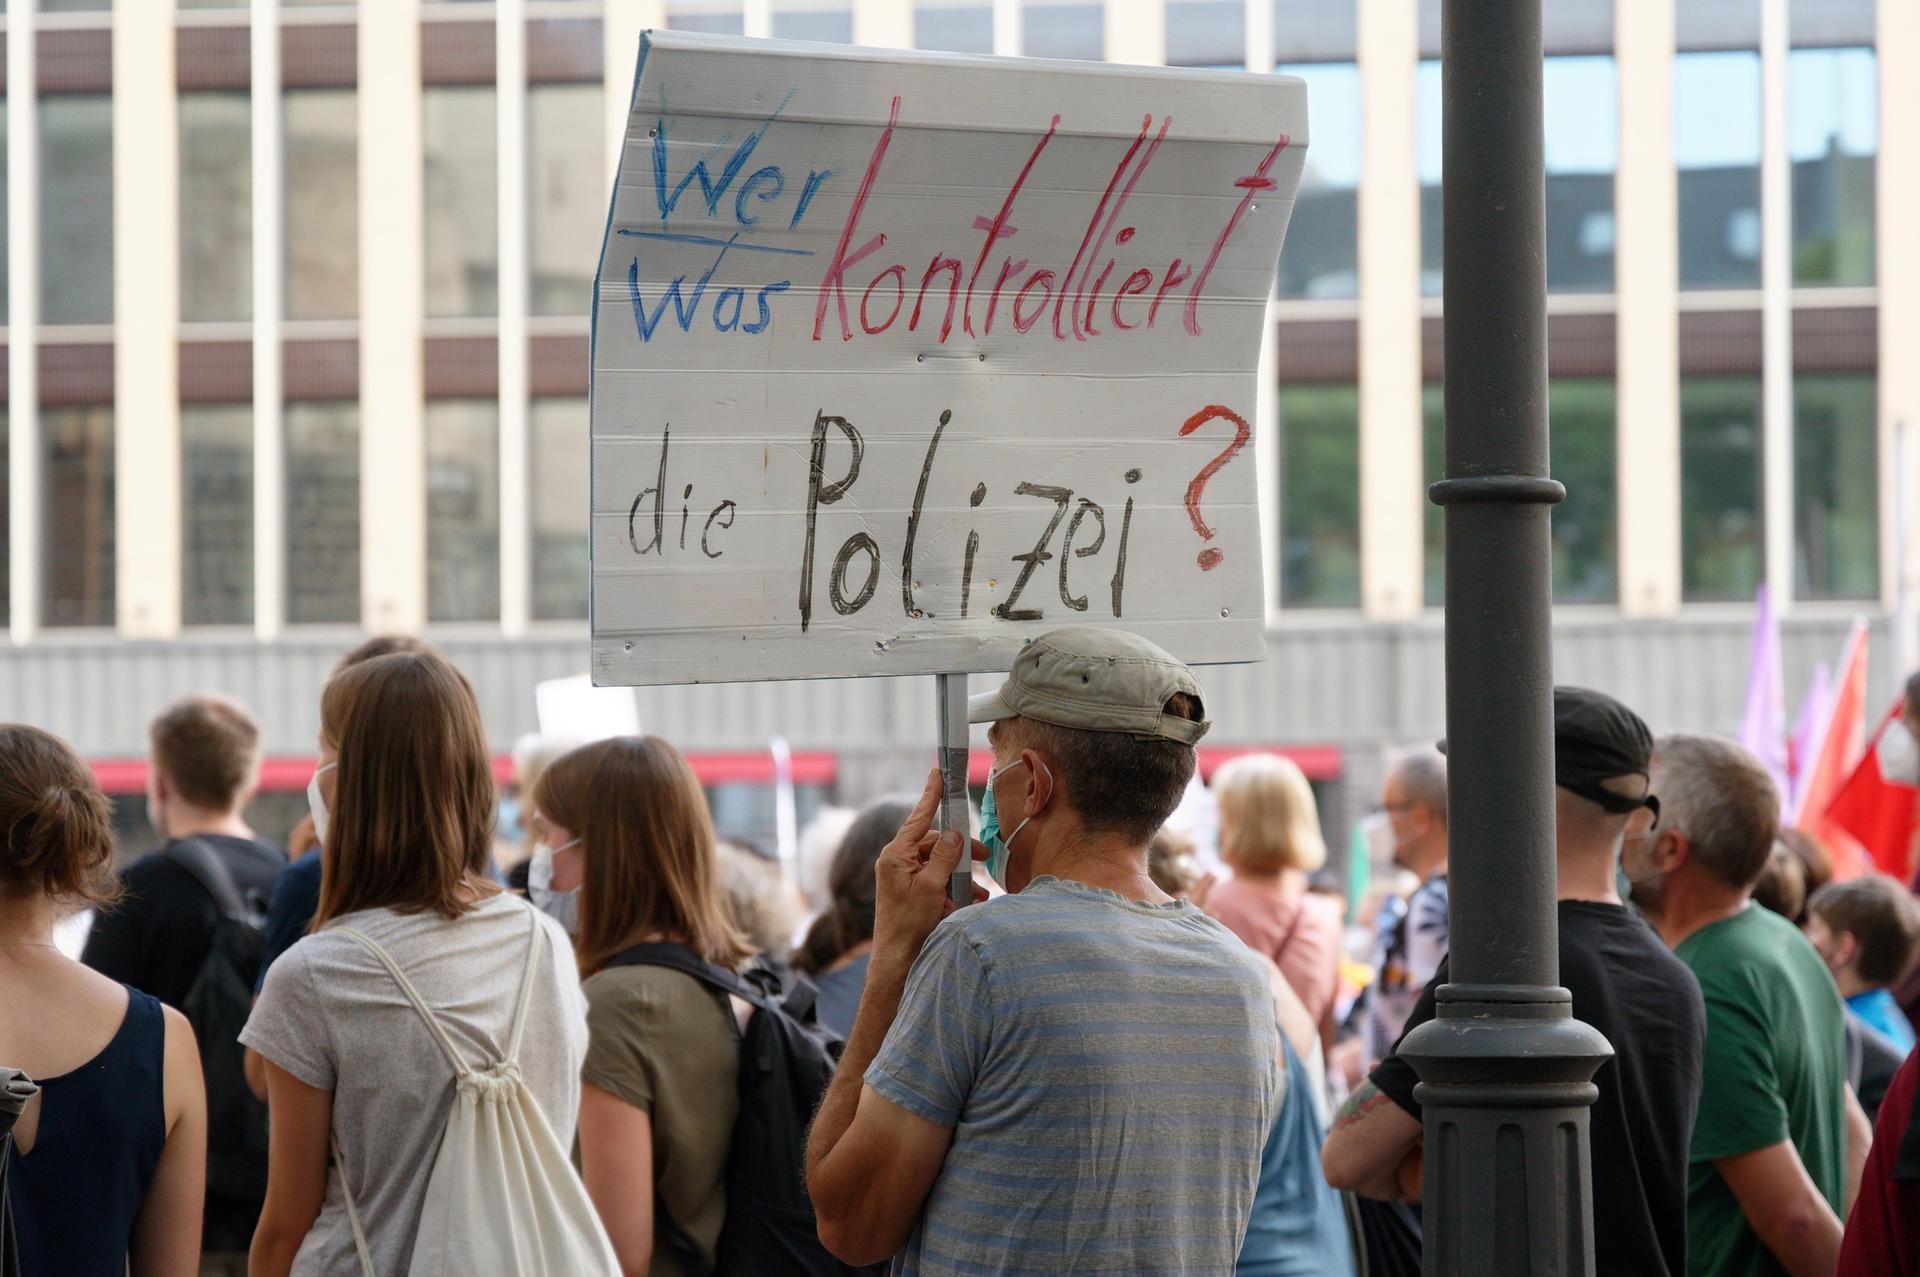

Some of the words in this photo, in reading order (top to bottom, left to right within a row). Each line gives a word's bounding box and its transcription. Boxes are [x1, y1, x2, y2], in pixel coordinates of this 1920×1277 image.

[627, 232, 791, 343] Was
[812, 96, 1290, 342] kontrolliert
[650, 84, 838, 233] Wer
[628, 423, 736, 558] die
